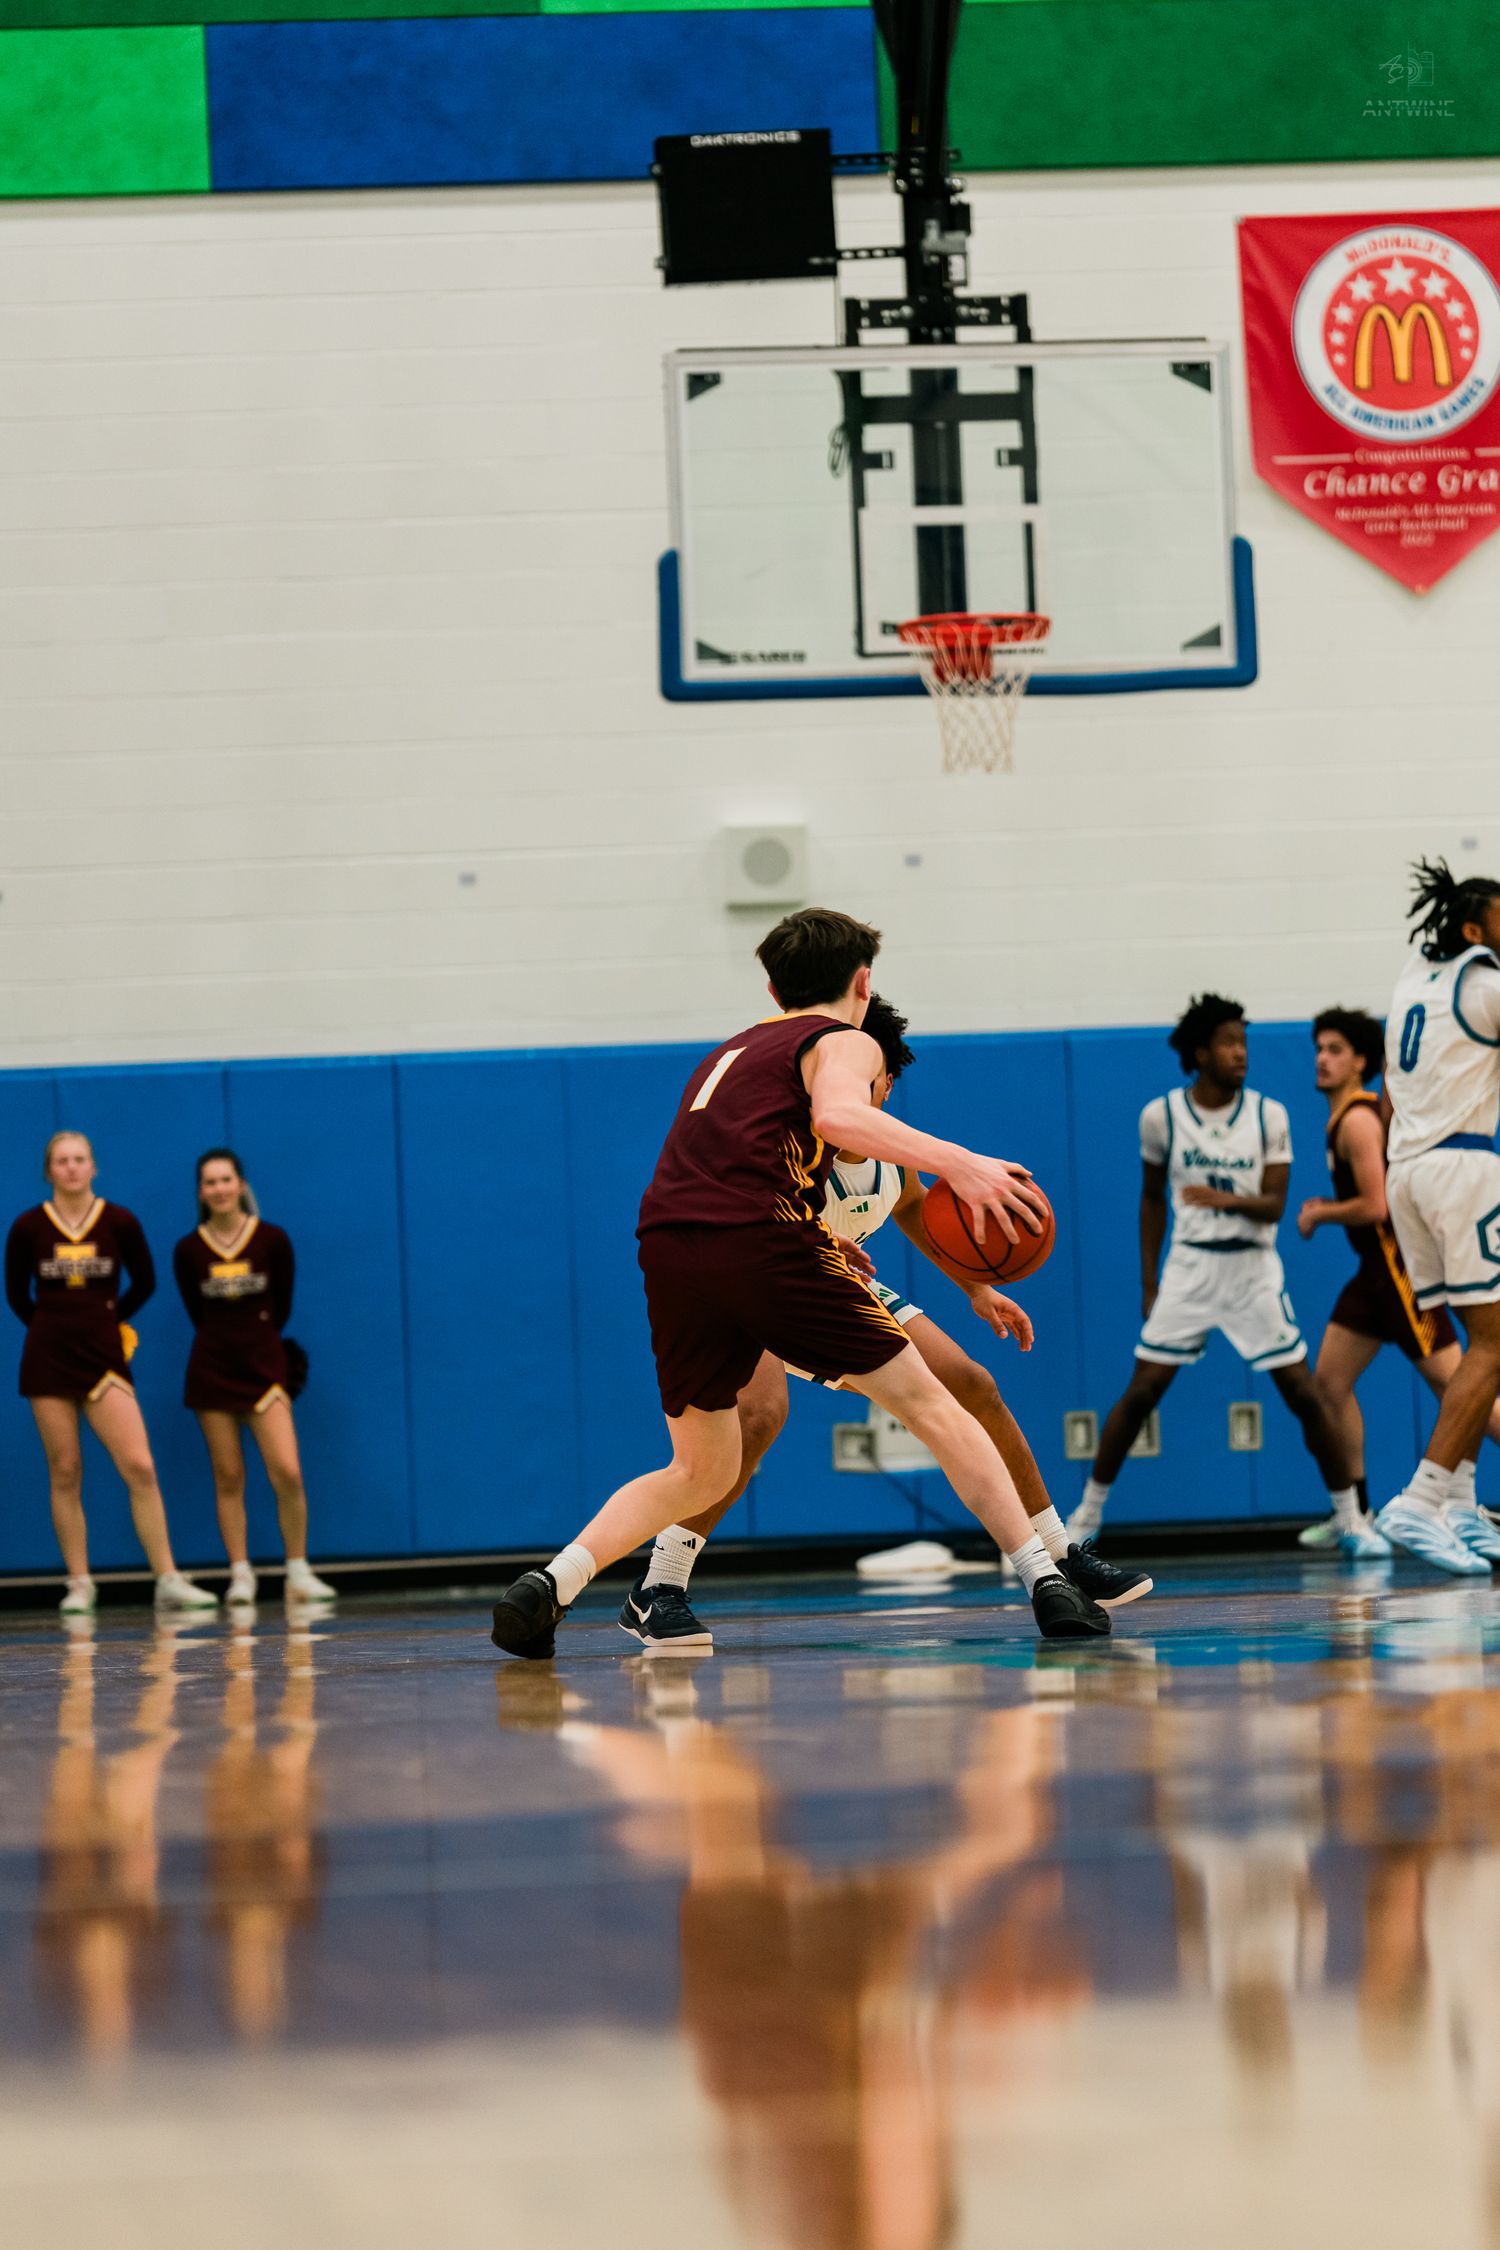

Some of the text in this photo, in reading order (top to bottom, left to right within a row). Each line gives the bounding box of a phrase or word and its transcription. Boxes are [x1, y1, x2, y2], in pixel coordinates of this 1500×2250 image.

[690, 130, 801, 147] DAKTRONICS
[1303, 465, 1427, 499] Chance
[1400, 1003, 1425, 1072] 0
[689, 1046, 747, 1112] 1
